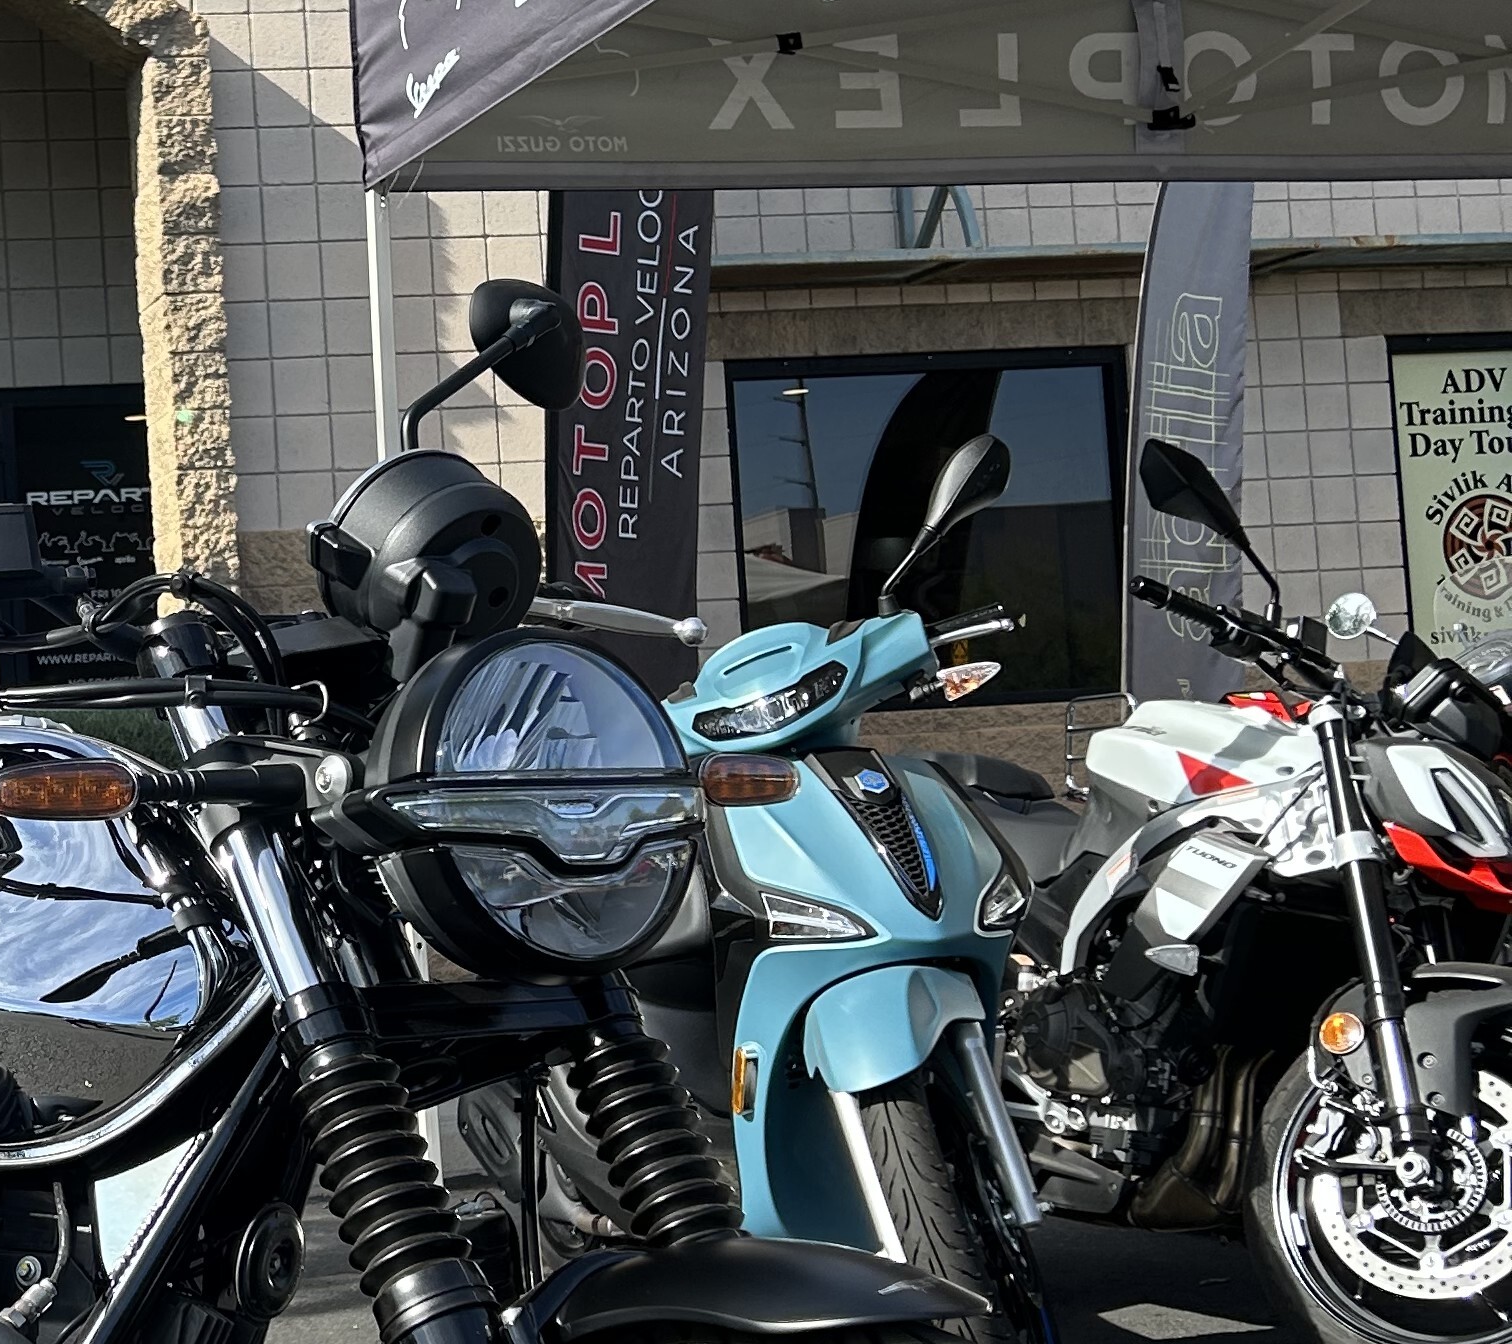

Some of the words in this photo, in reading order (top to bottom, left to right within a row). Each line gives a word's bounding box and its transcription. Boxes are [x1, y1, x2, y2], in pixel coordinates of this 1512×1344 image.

[406, 46, 460, 119] Vespa
[660, 224, 700, 479] ARIZONA
[1441, 367, 1508, 394] ADV
[618, 337, 652, 540] REPARTO
[1150, 292, 1230, 643] apilia
[1408, 433, 1465, 464] Day
[1425, 469, 1490, 527] Sivlik
[1185, 845, 1238, 869] TUONO
